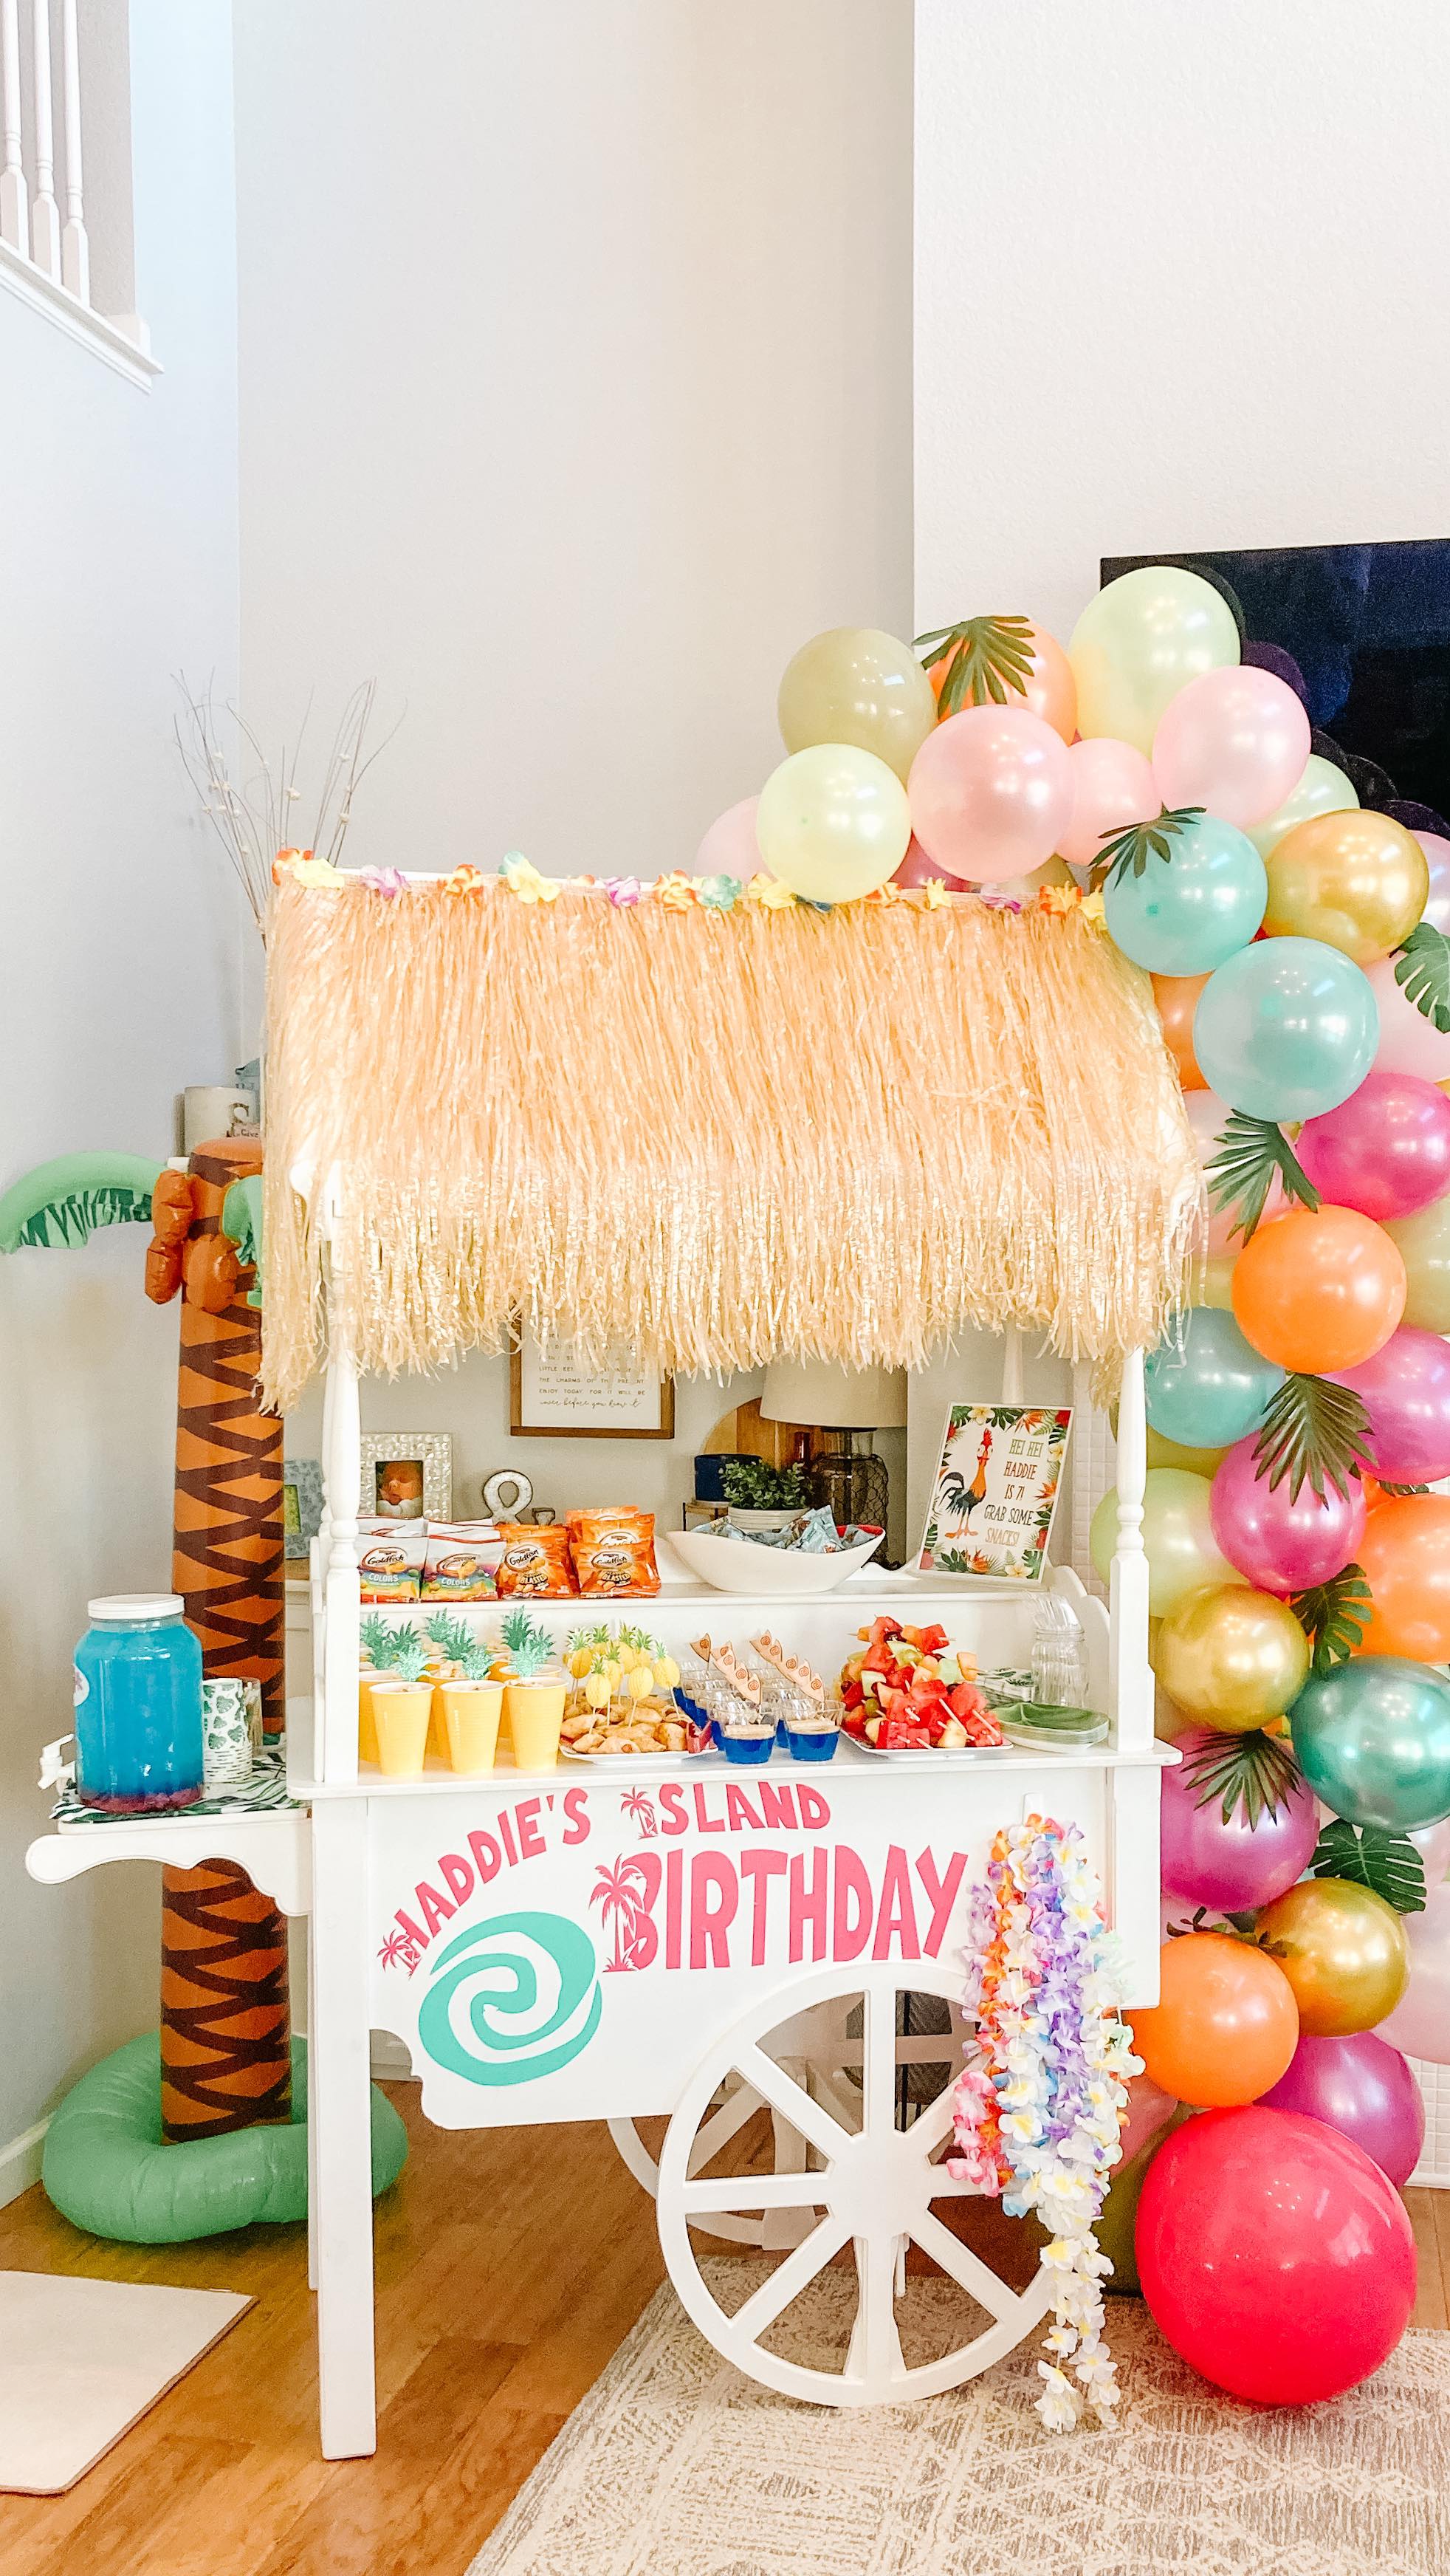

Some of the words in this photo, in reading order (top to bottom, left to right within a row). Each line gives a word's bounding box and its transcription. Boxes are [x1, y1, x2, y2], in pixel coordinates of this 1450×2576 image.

[1009, 1439, 1025, 1455] HEI
[1027, 1441, 1044, 1457] HEI
[1003, 1461, 1038, 1480] HADDIE
[1004, 1484, 1016, 1500] IS
[1017, 1486, 1025, 1501] 7!
[984, 1504, 1006, 1521] GRAB
[1009, 1507, 1034, 1526] SOME
[985, 1527, 1020, 1546] SNACKS!
[367, 1554, 405, 1566] Goldfish
[509, 1549, 540, 1566] Goldfish
[596, 1556, 628, 1566] Goldfish
[368, 1572, 400, 1583] COLORS
[441, 1578, 471, 1586] COLORS
[377, 1787, 591, 1978] HADDIE'S
[589, 1843, 969, 1973] BIRTHDAY
